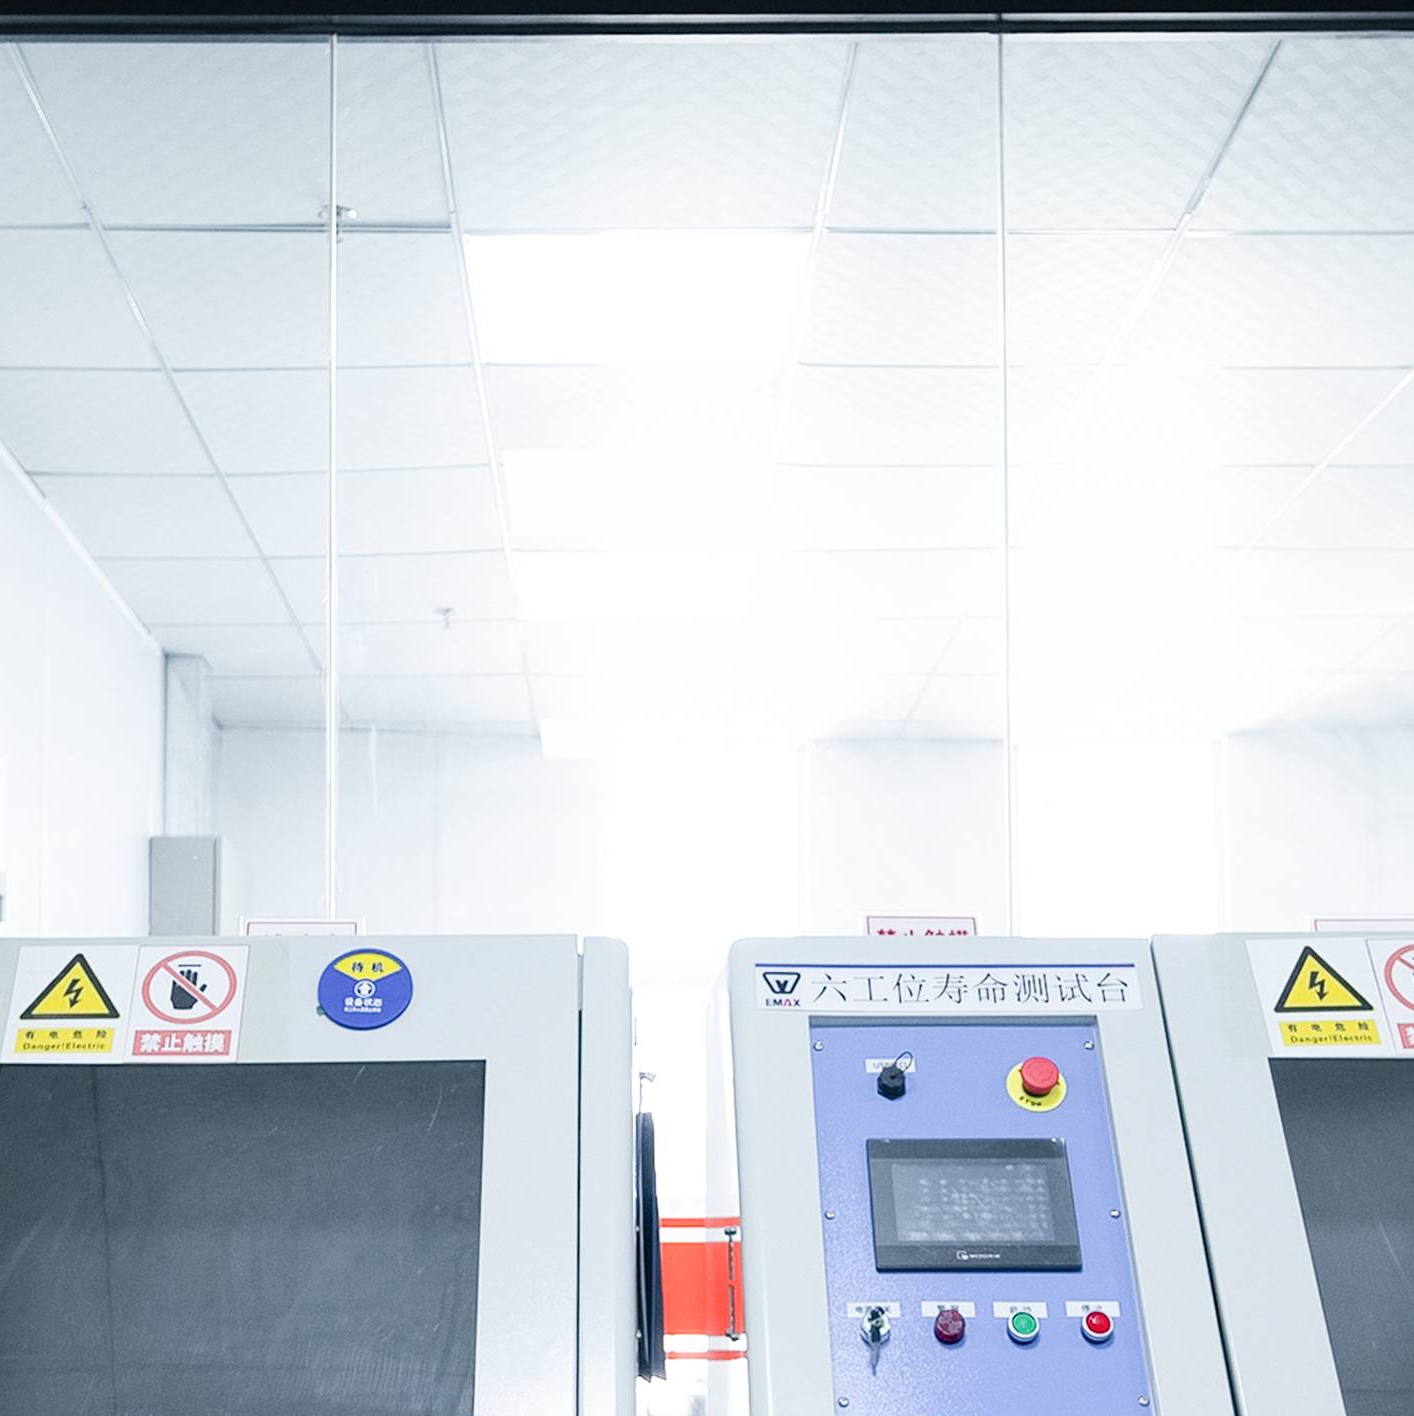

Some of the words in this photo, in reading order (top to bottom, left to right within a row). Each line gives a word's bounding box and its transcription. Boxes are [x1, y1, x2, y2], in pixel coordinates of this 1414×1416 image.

[810, 971, 1130, 1004] 六工位寿命测试台
[765, 998, 801, 1007] EMAX
[1288, 1022, 1369, 1033] 有电危险
[25, 1030, 107, 1039] 有电危险
[139, 1032, 226, 1053] 禁止触摸
